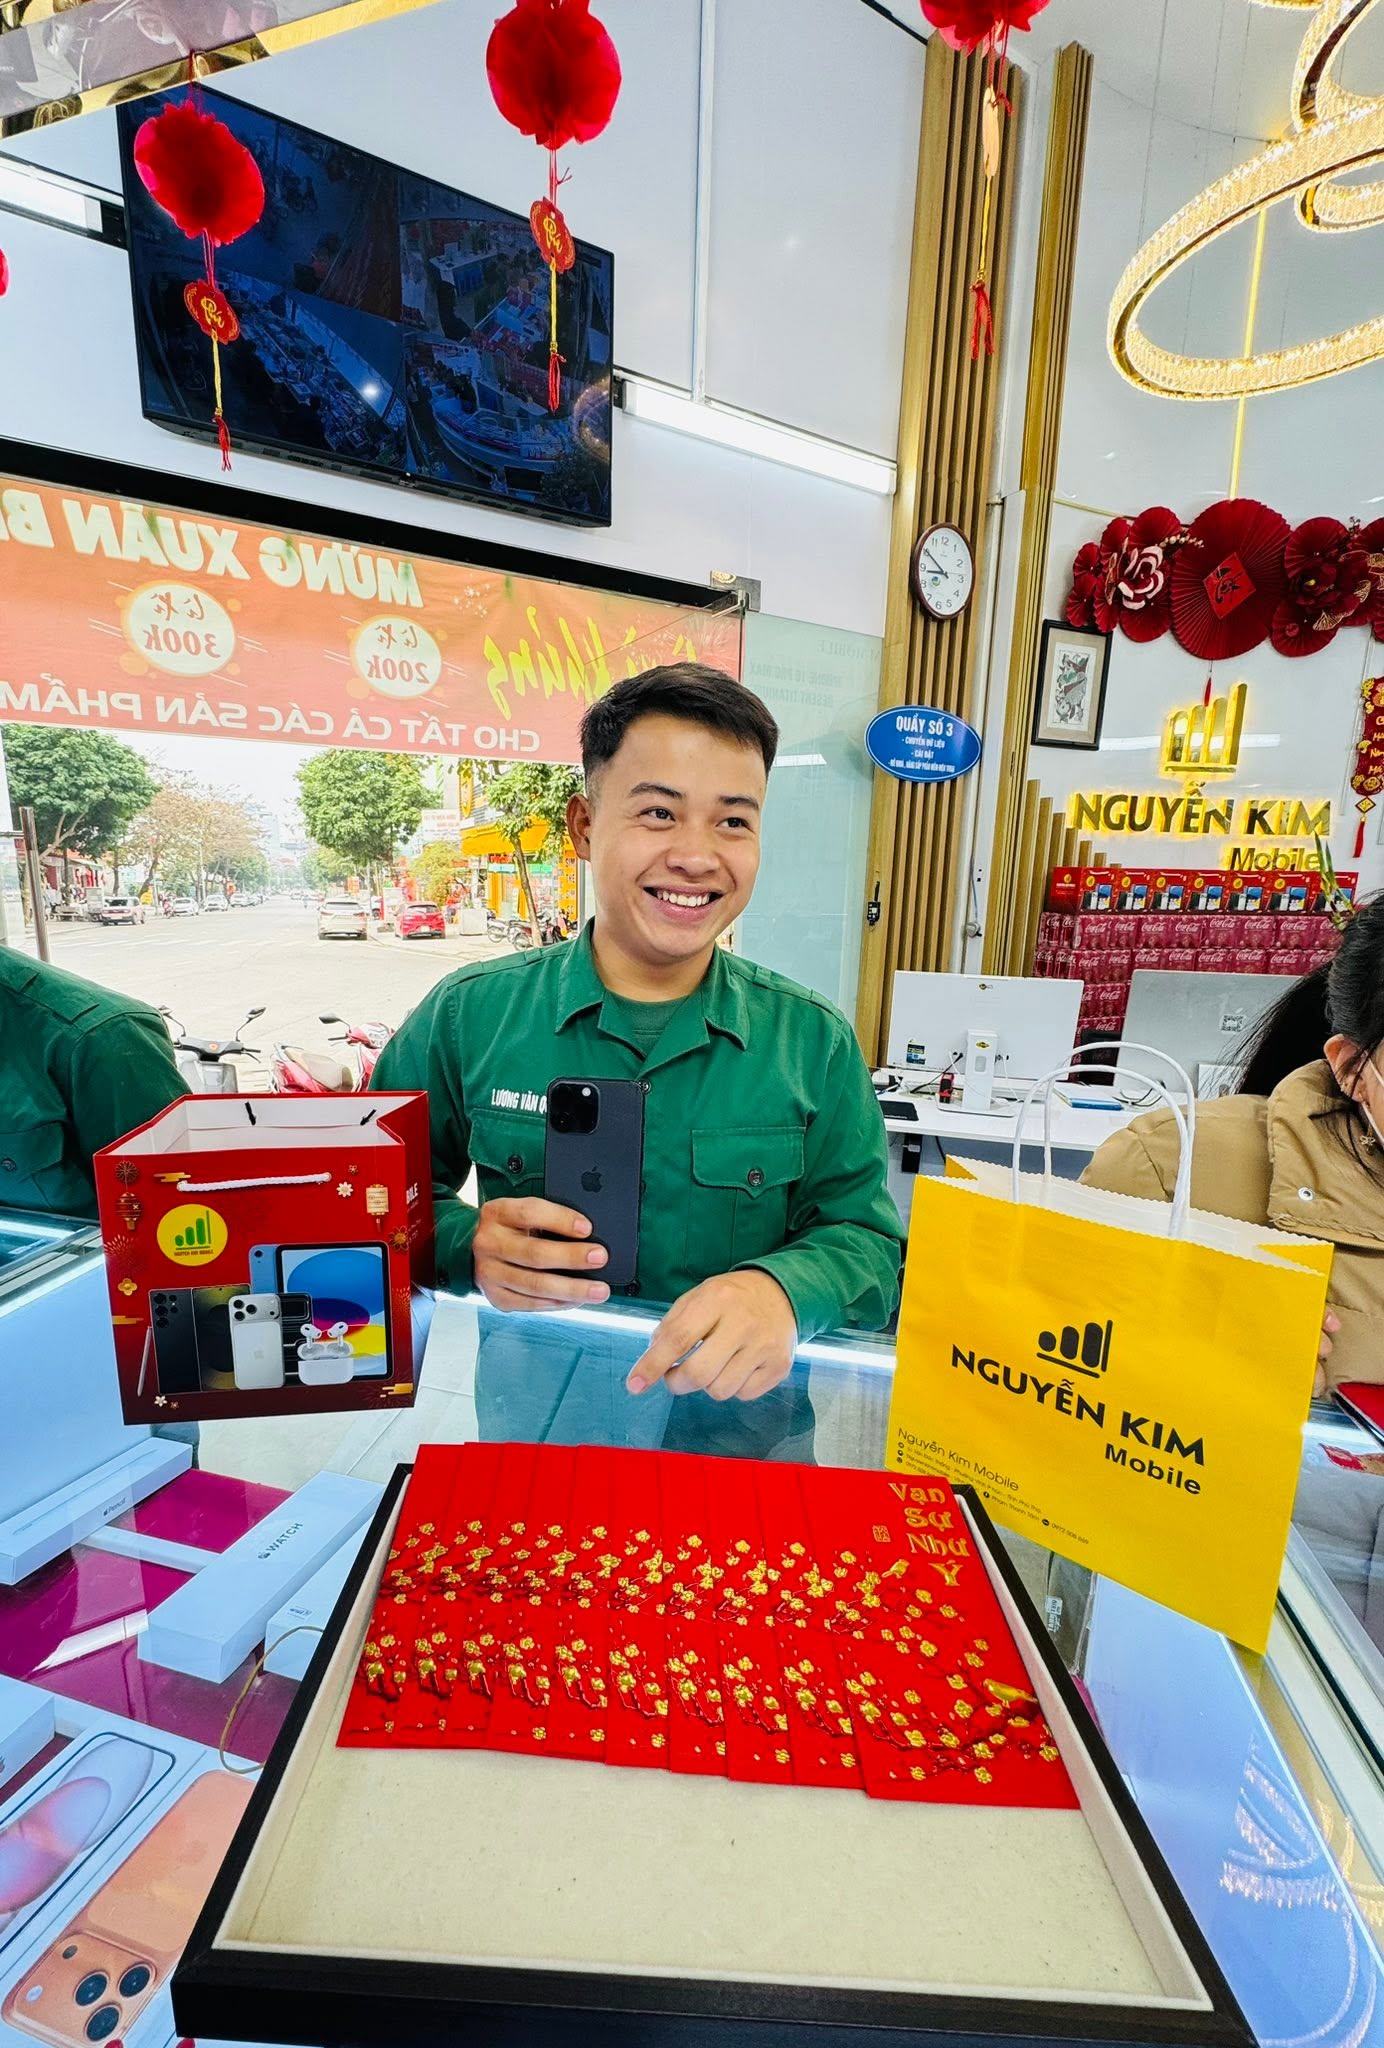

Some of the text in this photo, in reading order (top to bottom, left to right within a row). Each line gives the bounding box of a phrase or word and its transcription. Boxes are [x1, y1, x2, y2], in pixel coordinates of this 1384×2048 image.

[928, 717, 944, 736] SỐ
[946, 723, 954, 737] 3
[1075, 781, 1332, 836] NGUYỄN KIM
[1230, 847, 1321, 871] Mobile
[491, 1088, 519, 1109] LƯƠNG
[520, 1090, 538, 1112] VĂN
[951, 1343, 1205, 1466] NGUYỄN KIM
[898, 1428, 945, 1456] Nguyễn
[948, 1450, 971, 1469] Kim
[974, 1462, 1019, 1491] Mobile
[1104, 1443, 1201, 1495] Mobile
[888, 1483, 946, 1505] Vạn
[904, 1507, 954, 1532] Sự
[265, 1523, 303, 1551] WATCH
[906, 1533, 970, 1557] Như
